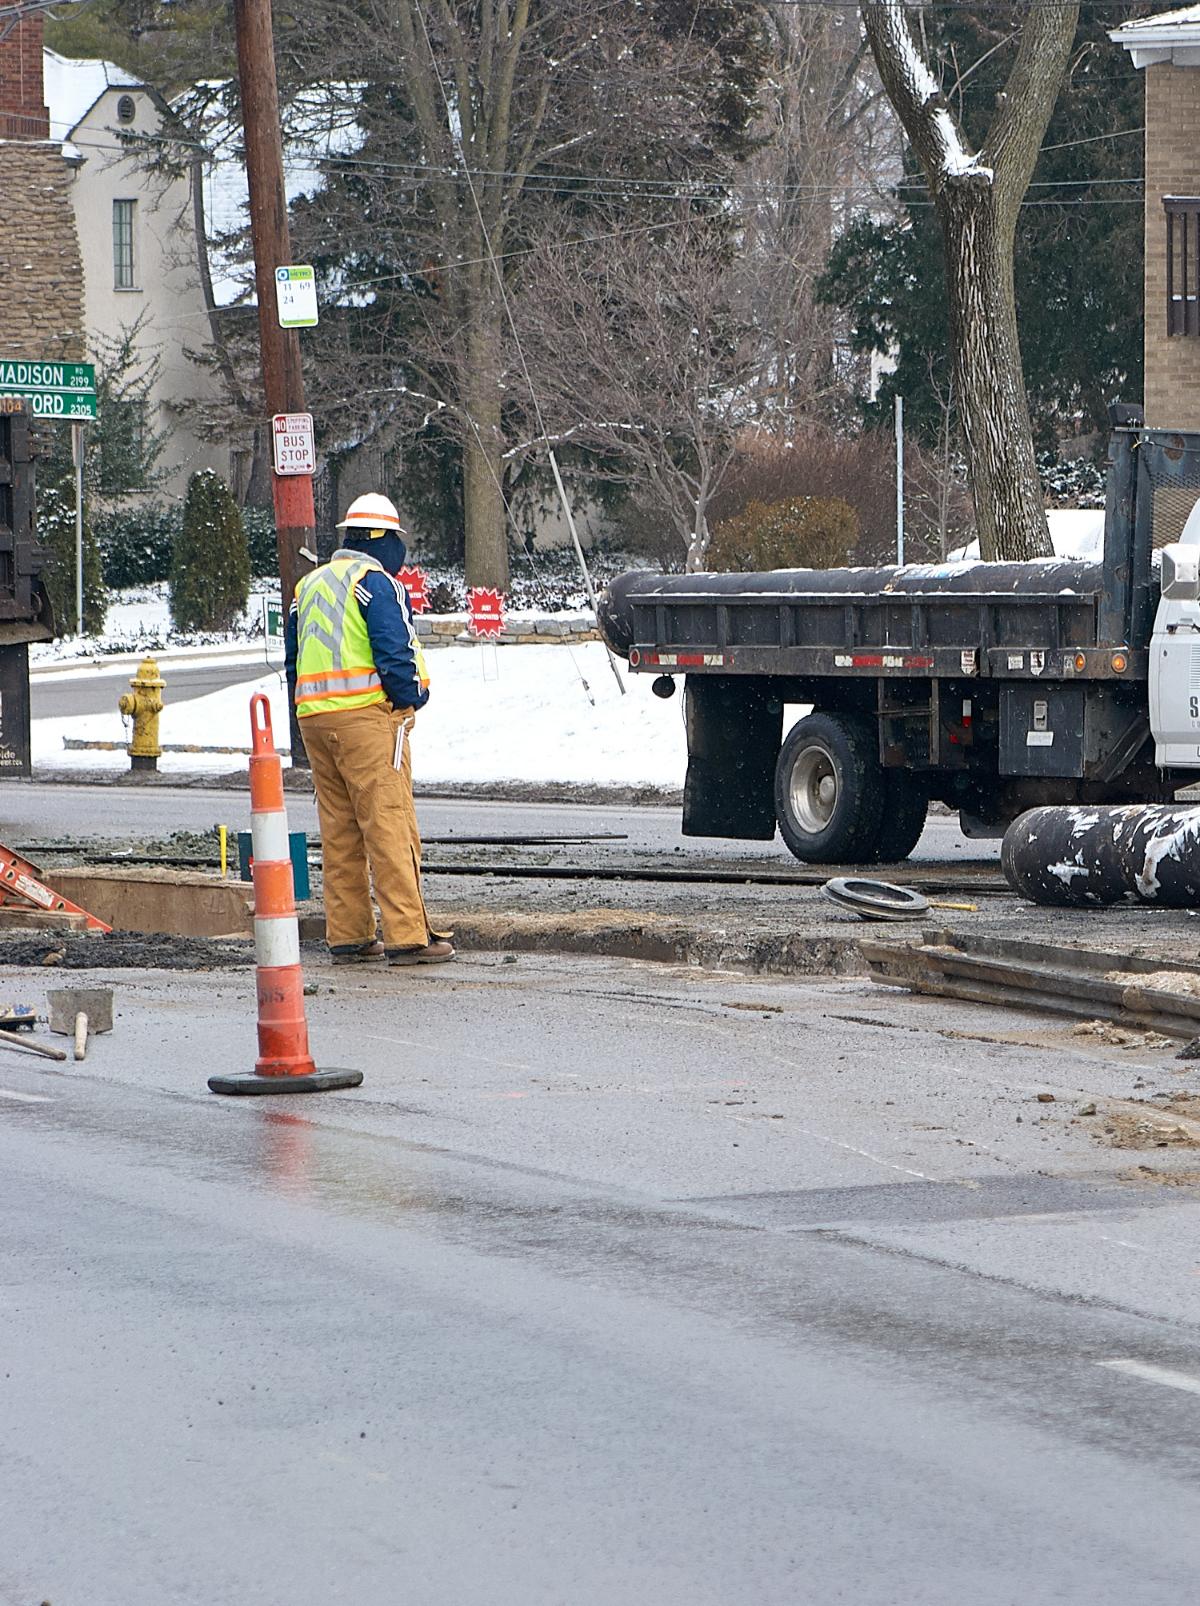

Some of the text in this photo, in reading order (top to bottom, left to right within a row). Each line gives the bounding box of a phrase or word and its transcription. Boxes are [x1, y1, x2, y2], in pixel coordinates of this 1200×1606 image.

[284, 283, 292, 291] 11
[283, 295, 294, 305] 24
[70, 376, 89, 387] 2199
[70, 404, 92, 416] 2305
[275, 419, 286, 431] NO
[283, 435, 305, 447] BUS
[281, 449, 309, 462] STOP
